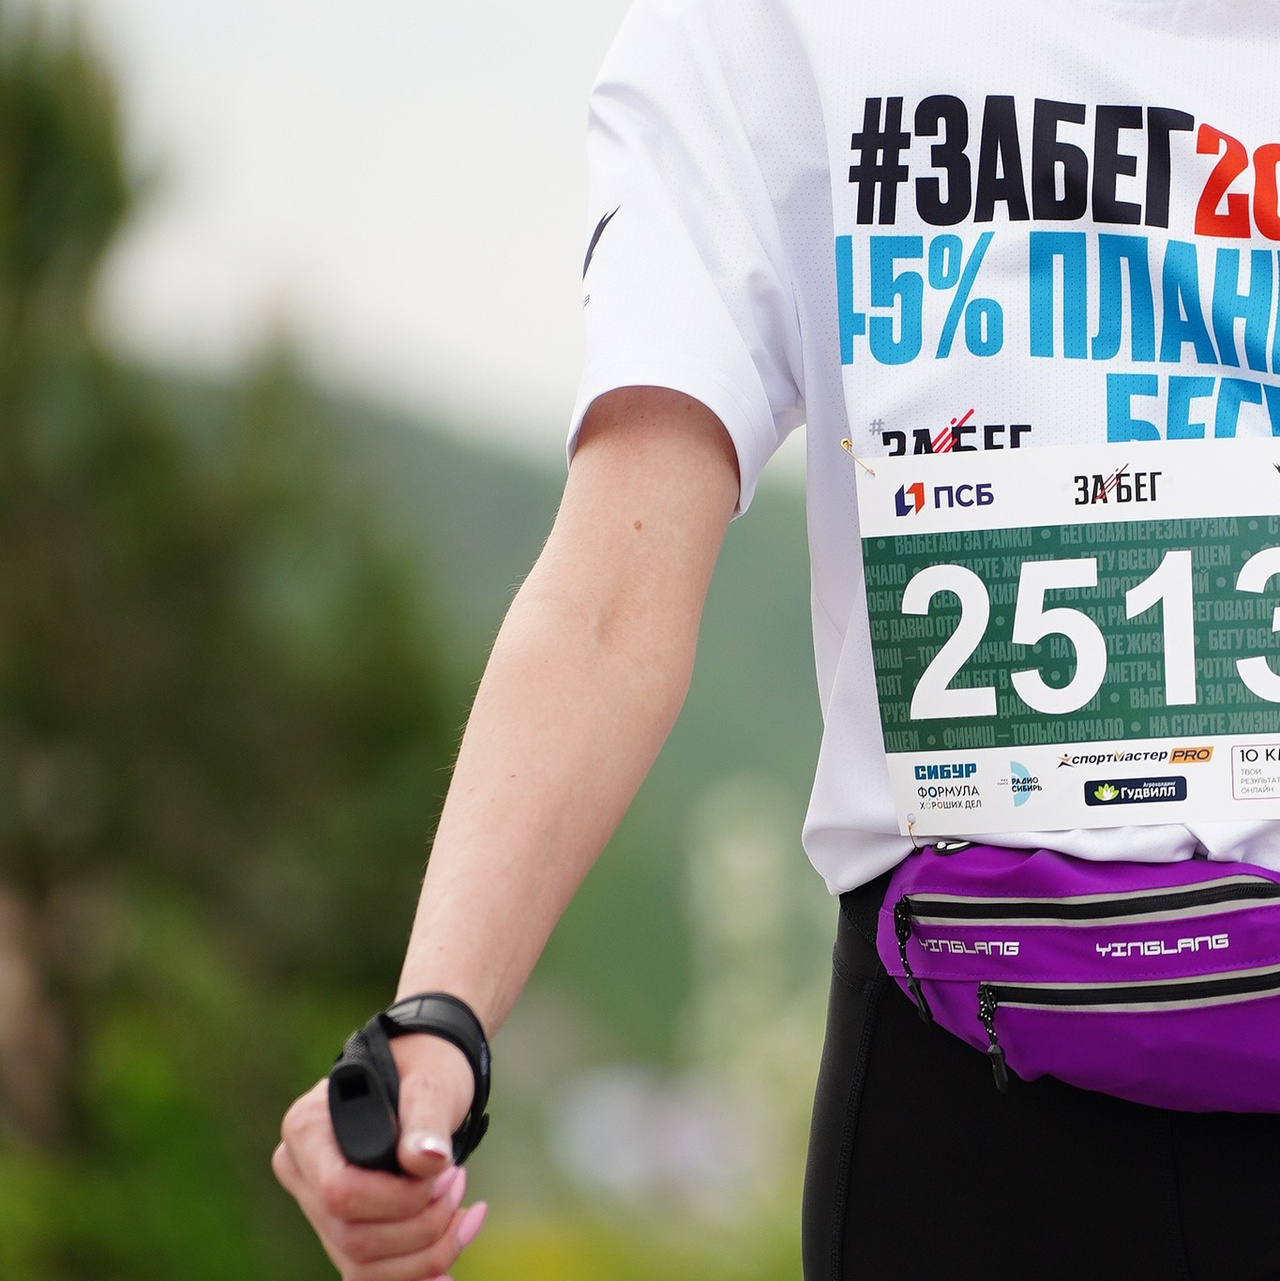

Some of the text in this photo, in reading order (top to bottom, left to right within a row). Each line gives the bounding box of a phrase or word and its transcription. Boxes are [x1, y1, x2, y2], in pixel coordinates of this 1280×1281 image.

[934, 483, 995, 509] ПСБ
[894, 533, 962, 554] ВЫБЕГАЮ
[962, 532, 982, 550] ЗА
[983, 530, 1032, 549] РАМКИ
[1059, 525, 1125, 544] БЕГОВАЯ
[1126, 519, 1238, 541] ПЕРЕЗАГРУЗКА
[1117, 547, 1159, 570] ВСЕМ
[889, 616, 935, 642] ДАВНО
[1208, 628, 1244, 650] БЕГУ
[942, 725, 995, 748] ФИНИШ
[1011, 721, 1066, 744] ТОЛЬКО
[1067, 718, 1124, 741] НАЧАЛО
[1148, 715, 1168, 737] НА
[1171, 712, 1226, 735] СТАРТЕ
[1171, 749, 1210, 761] PRO
[1240, 749, 1259, 762] 10
[914, 763, 977, 780] СИБУР
[1011, 777, 1038, 785] РАДИО
[1011, 784, 1042, 792] СИБИРЬ
[917, 785, 980, 799] ФОРМУЛА
[1121, 786, 1176, 800] Гудвилл
[1241, 786, 1274, 794] ОНЛАЙН
[919, 799, 982, 810] ХОРОШИХ ДЕЛ
[919, 938, 1020, 956] YINGLANG
[1095, 933, 1229, 957] YINGLANG
